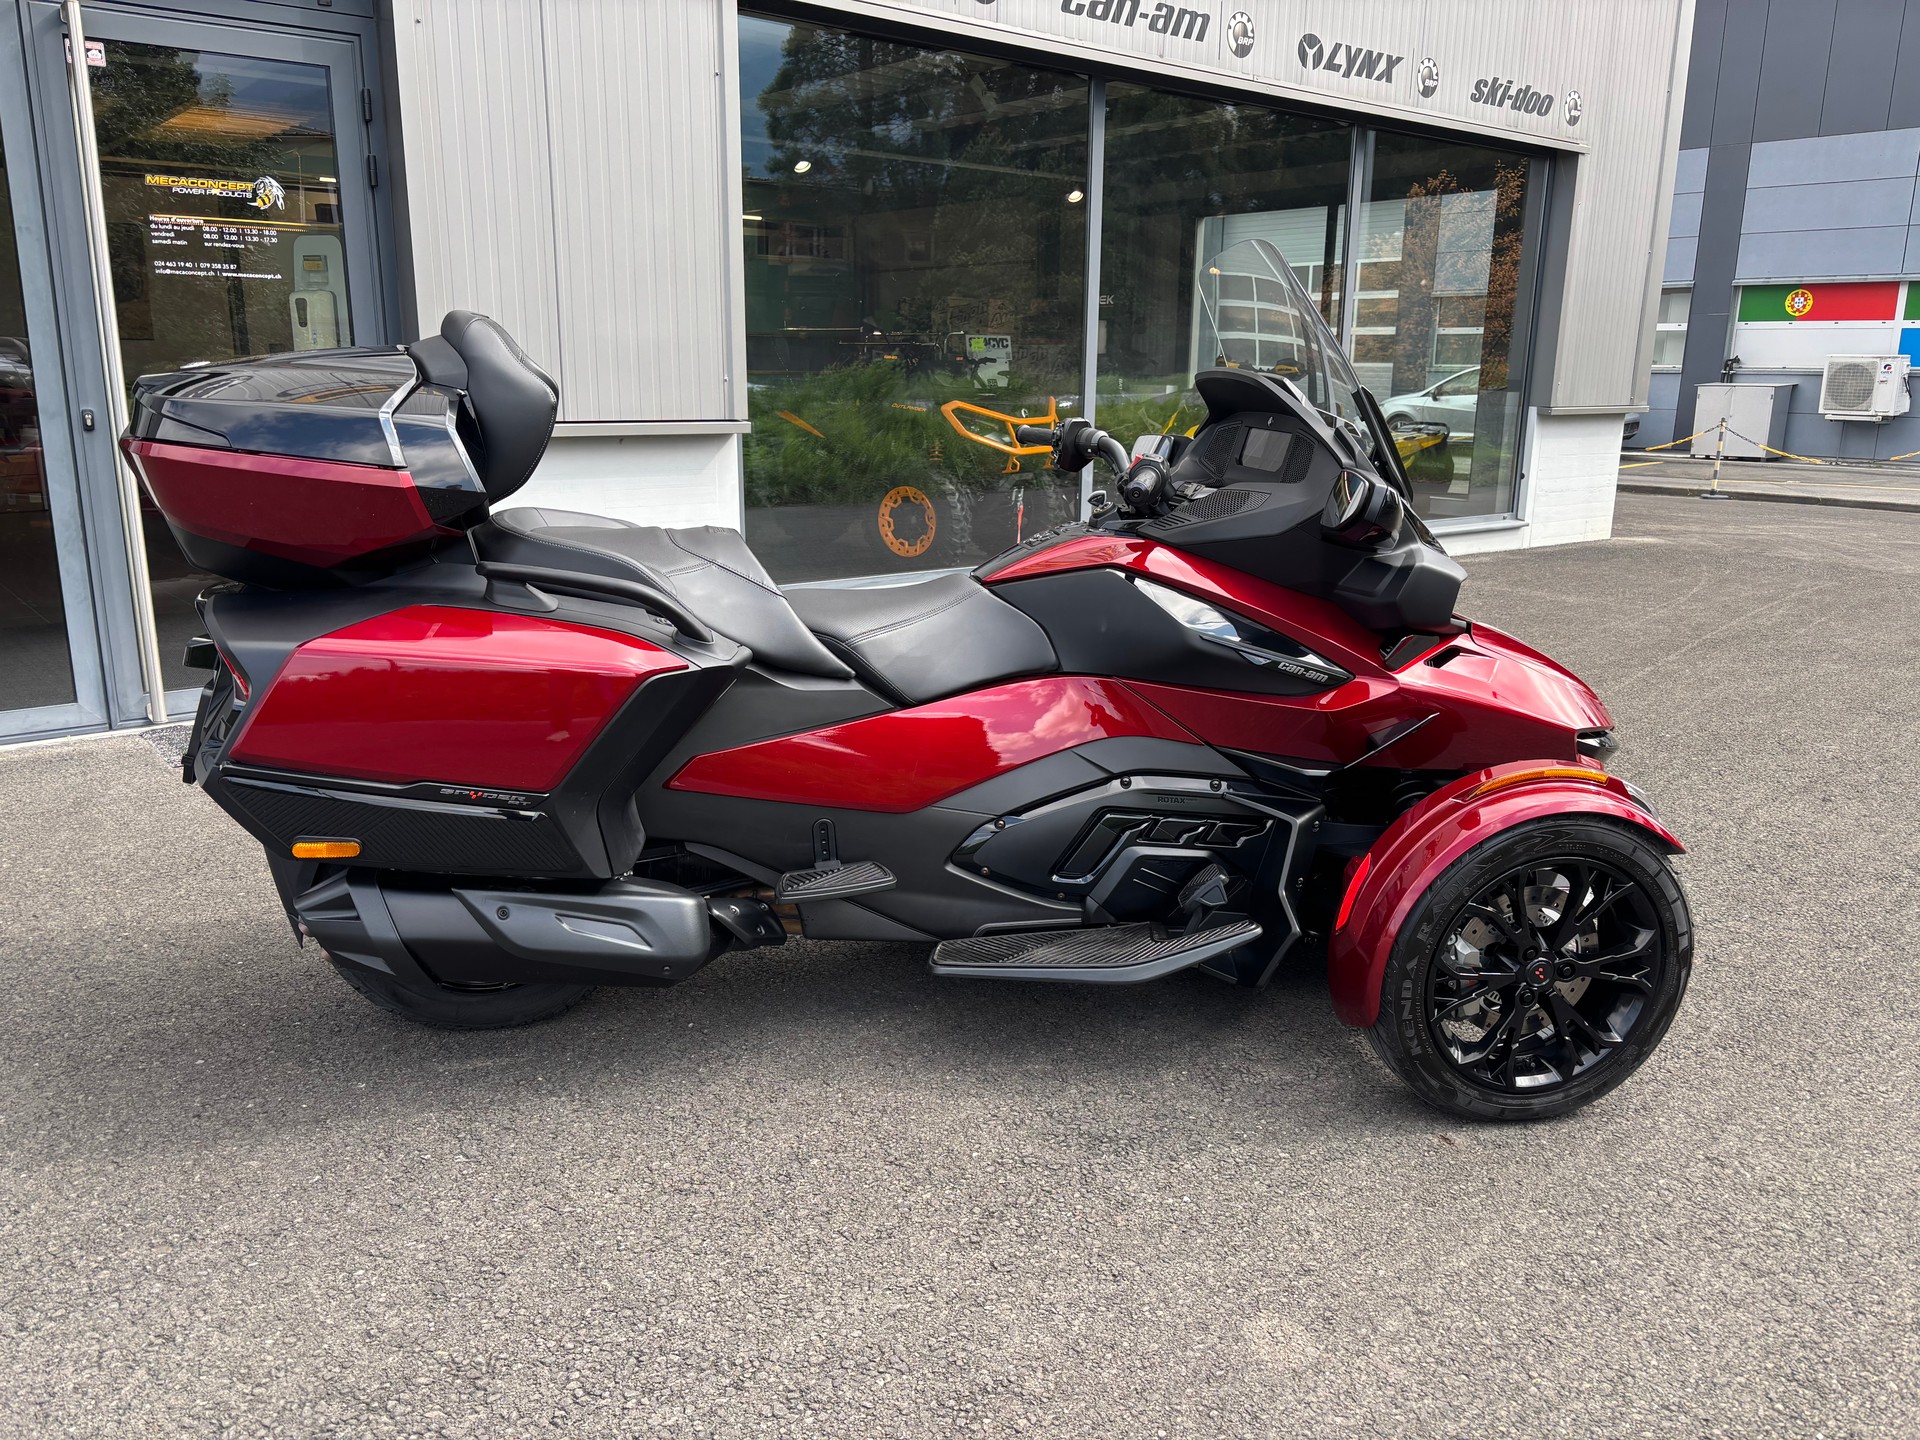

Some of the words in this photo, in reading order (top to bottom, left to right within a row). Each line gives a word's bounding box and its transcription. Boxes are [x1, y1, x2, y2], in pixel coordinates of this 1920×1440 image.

[1237, 36, 1253, 46] BRP
[1322, 42, 1405, 84] LYNX
[1424, 79, 1438, 88] BRP
[1470, 77, 1555, 117] ski-doo
[145, 174, 256, 193] MECACONCEPT
[172, 186, 206, 196] POWER
[206, 187, 253, 199] PRODUCTS
[181, 224, 195, 232] jeudi
[155, 268, 215, 277] info@mecaconcept.ch
[222, 272, 282, 280] www.mecaconcept.ch
[1278, 661, 1329, 683] can-am
[440, 787, 526, 801] SPYDER
[1157, 795, 1186, 804] ROTAX
[1400, 955, 1422, 1057] KENDA
